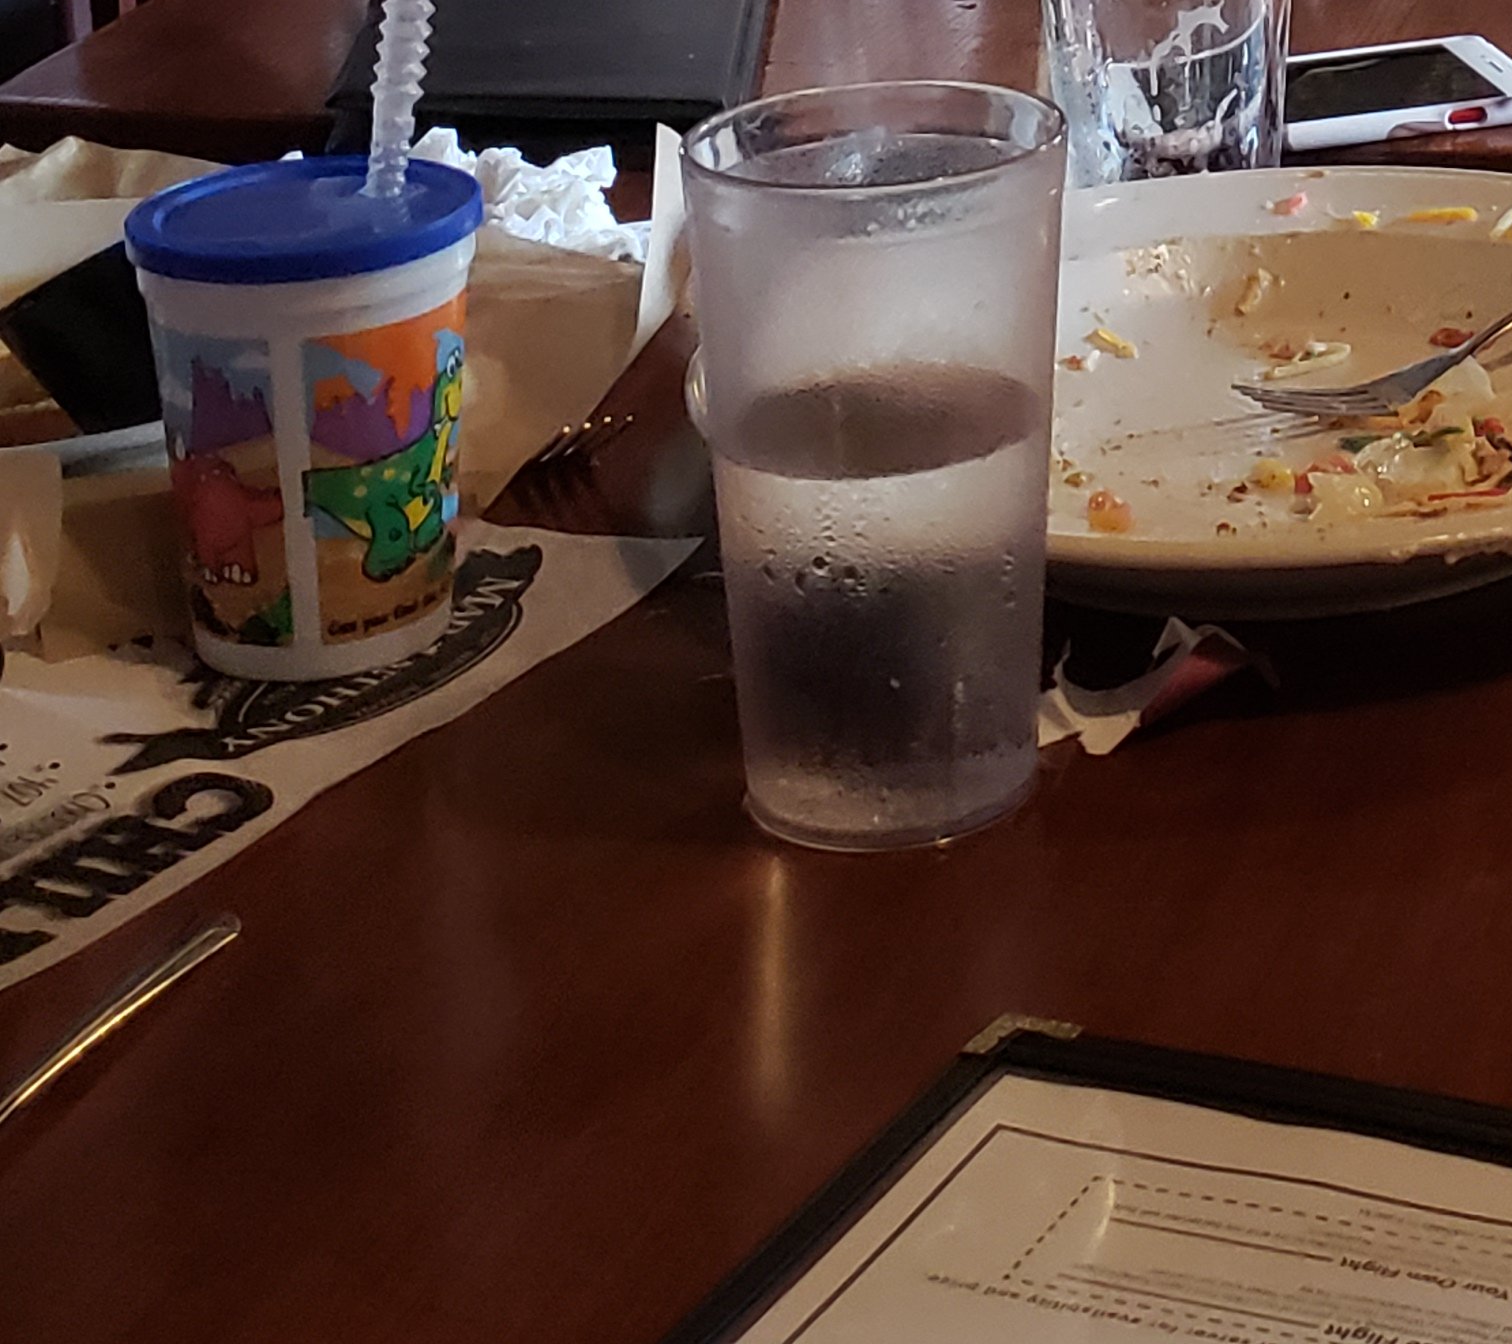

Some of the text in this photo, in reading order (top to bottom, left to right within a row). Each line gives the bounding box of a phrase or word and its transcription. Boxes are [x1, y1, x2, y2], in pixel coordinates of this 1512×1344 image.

[1338, 1255, 1400, 1279] Flight
[1406, 1270, 1457, 1290] Own
[1462, 1281, 1510, 1302] Your
